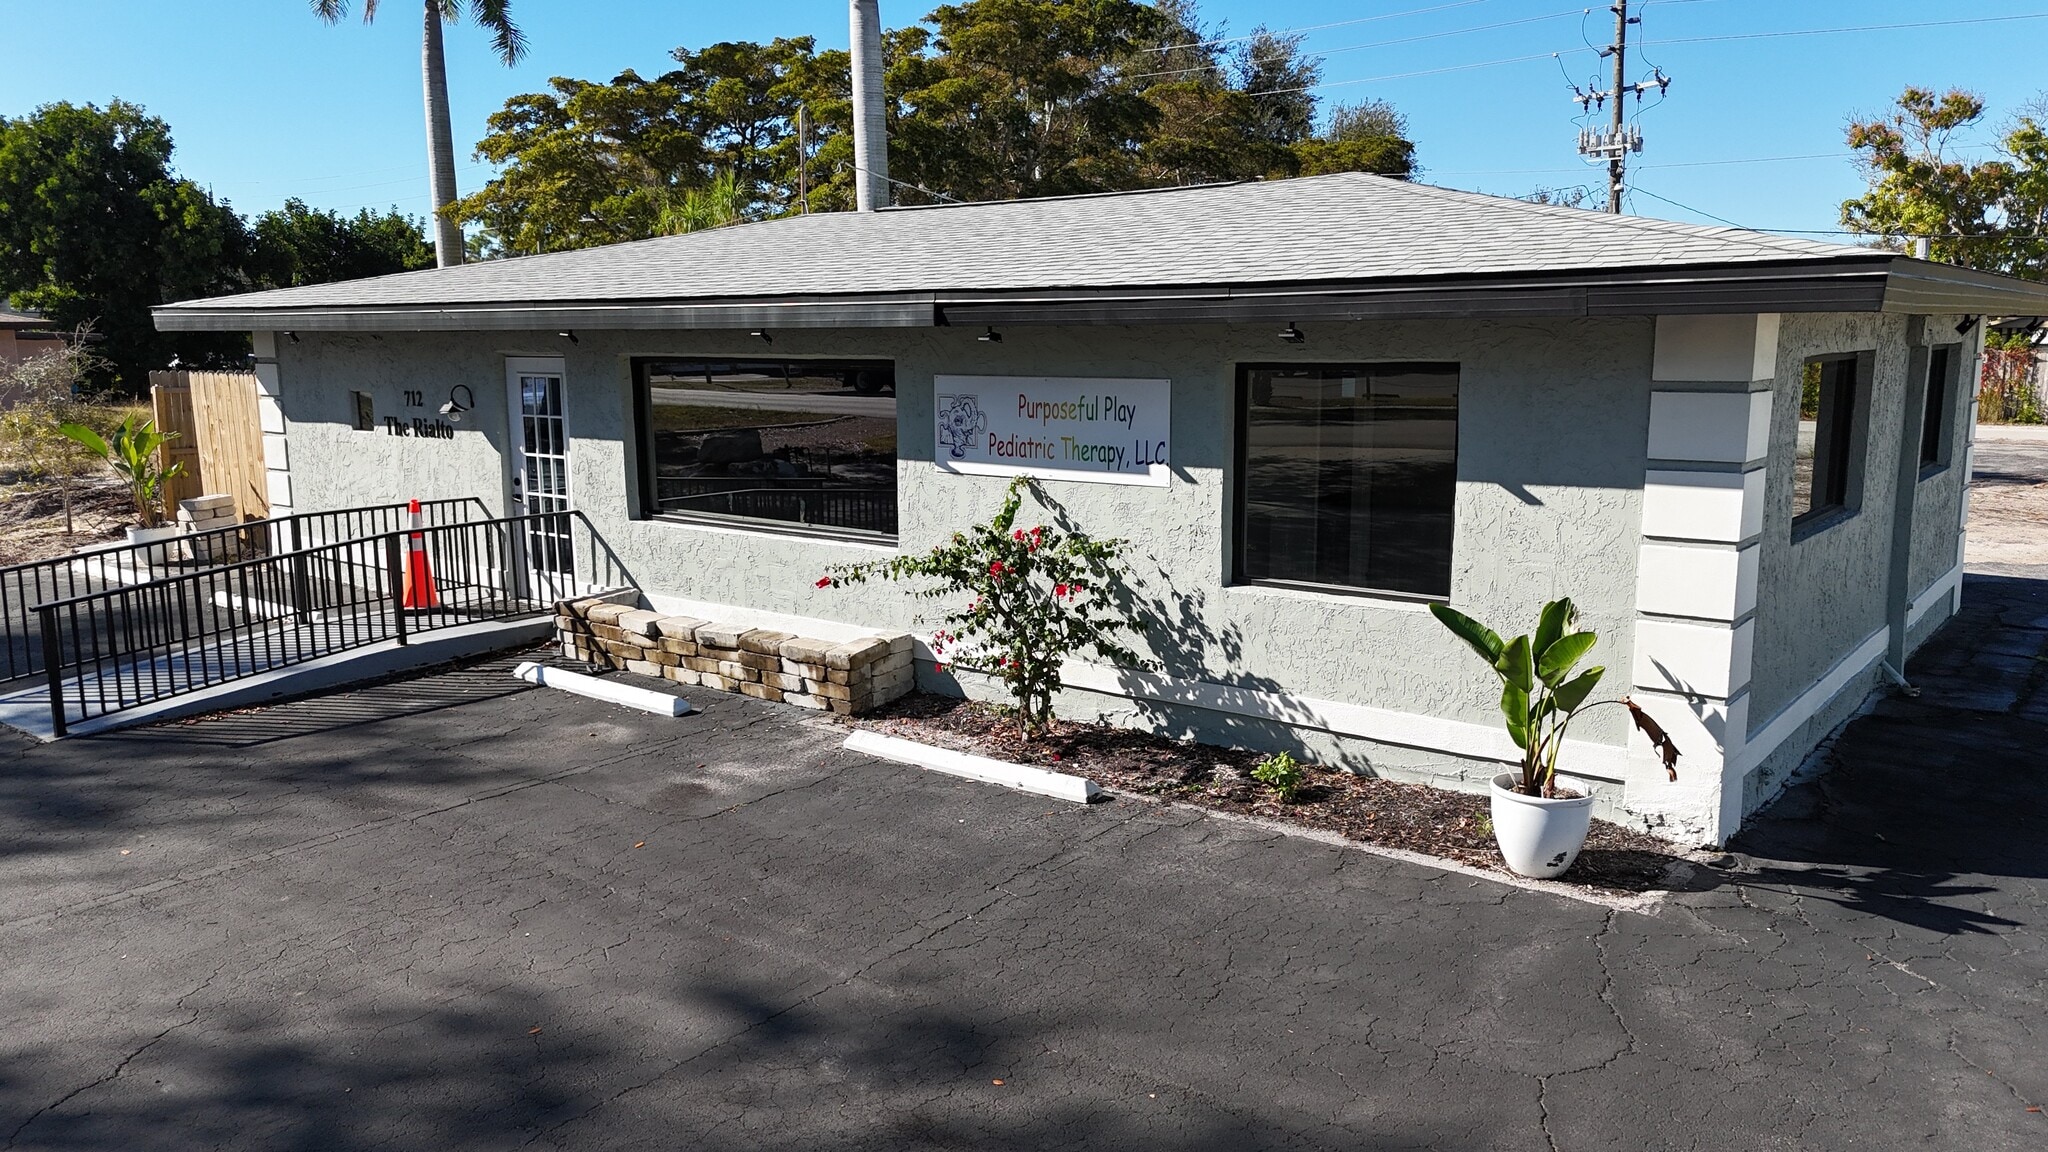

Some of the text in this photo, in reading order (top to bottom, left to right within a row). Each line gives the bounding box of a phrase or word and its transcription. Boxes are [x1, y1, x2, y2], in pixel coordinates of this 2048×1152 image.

[404, 391, 423, 407] 712
[1018, 394, 1136, 429] Purposeful Play
[384, 416, 454, 440] The Rialto
[989, 433, 1054, 460] Pediatric
[1061, 437, 1129, 470] Therapy,
